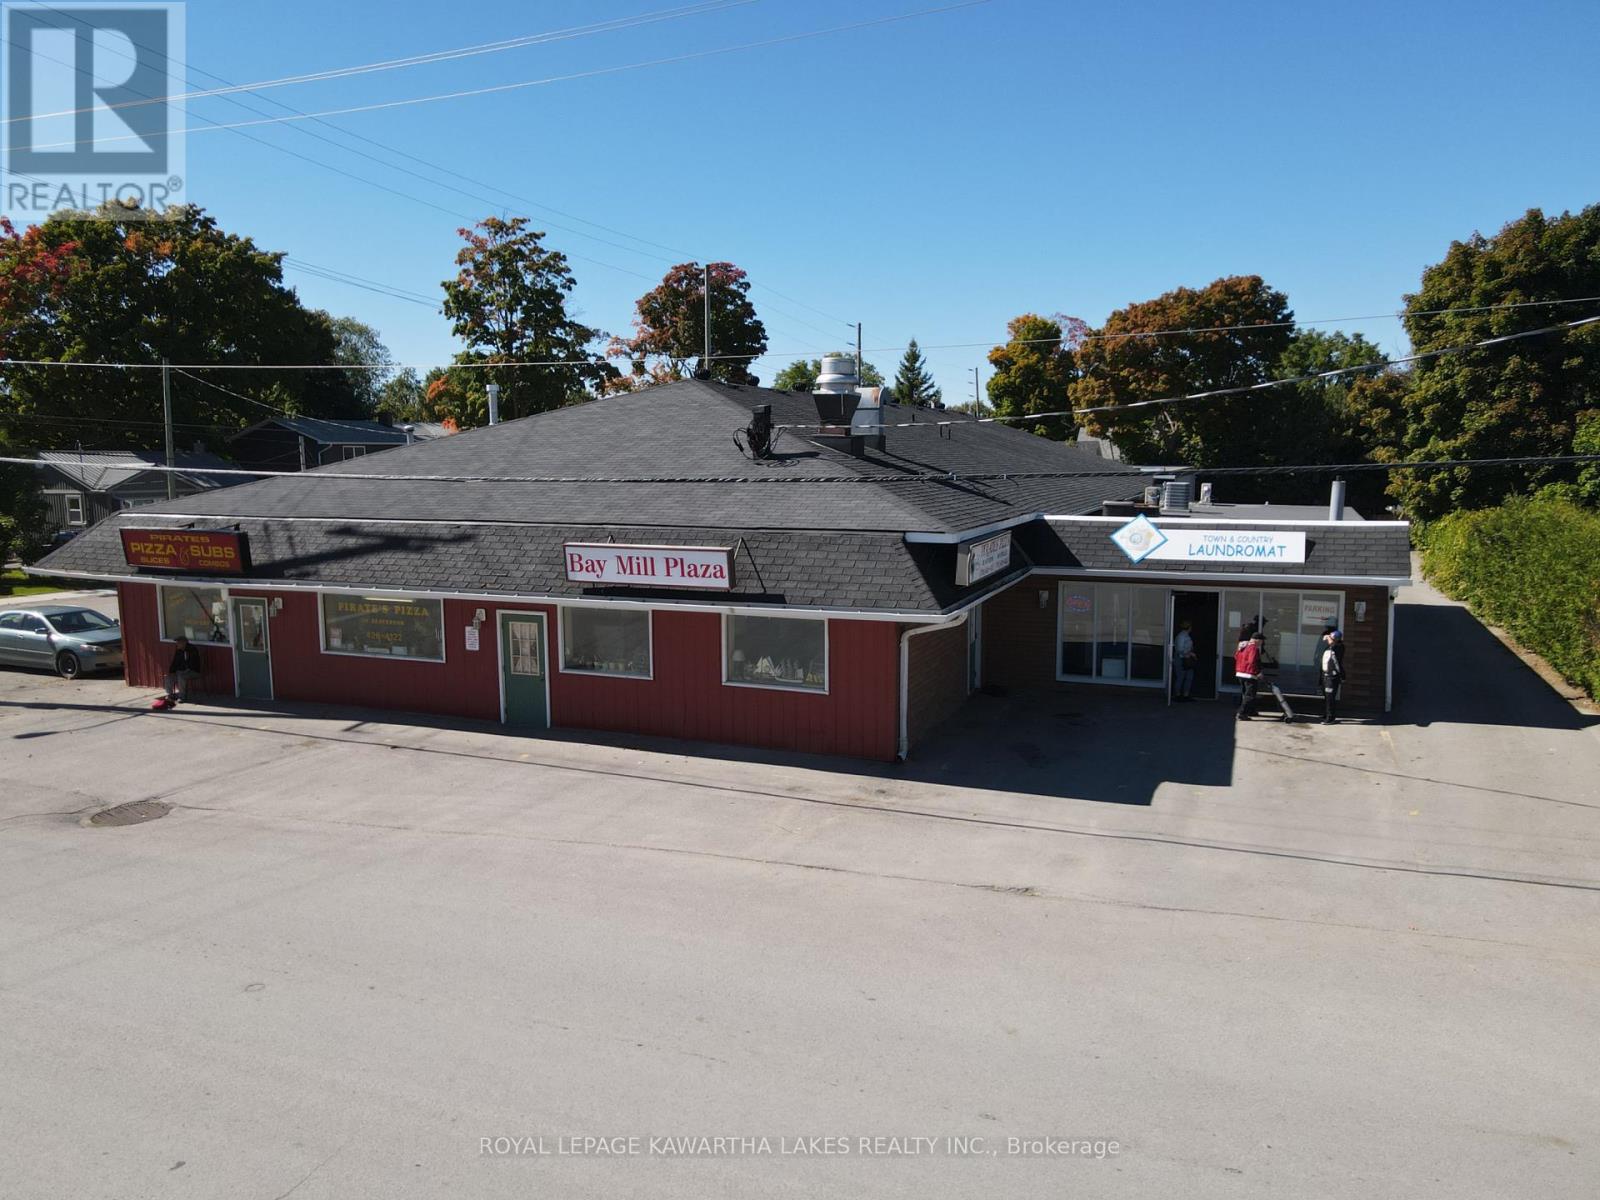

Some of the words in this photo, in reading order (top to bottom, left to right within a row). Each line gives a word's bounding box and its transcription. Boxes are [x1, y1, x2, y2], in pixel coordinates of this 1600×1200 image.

[150, 533, 210, 543] PIRATES
[1203, 534, 1226, 544] TOWN
[1230, 535, 1235, 543] &
[1237, 536, 1274, 544] COUNTRY
[130, 542, 177, 556] PIZZA
[190, 545, 235, 559] SUBS
[1188, 544, 1287, 558] LAUNDROMAT
[140, 556, 171, 566] SLICES
[568, 552, 608, 578] Bay
[616, 555, 657, 577] Mill
[664, 557, 726, 579] Plaza
[394, 605, 430, 617] PIZZA
[1304, 604, 1336, 614] PARKING
